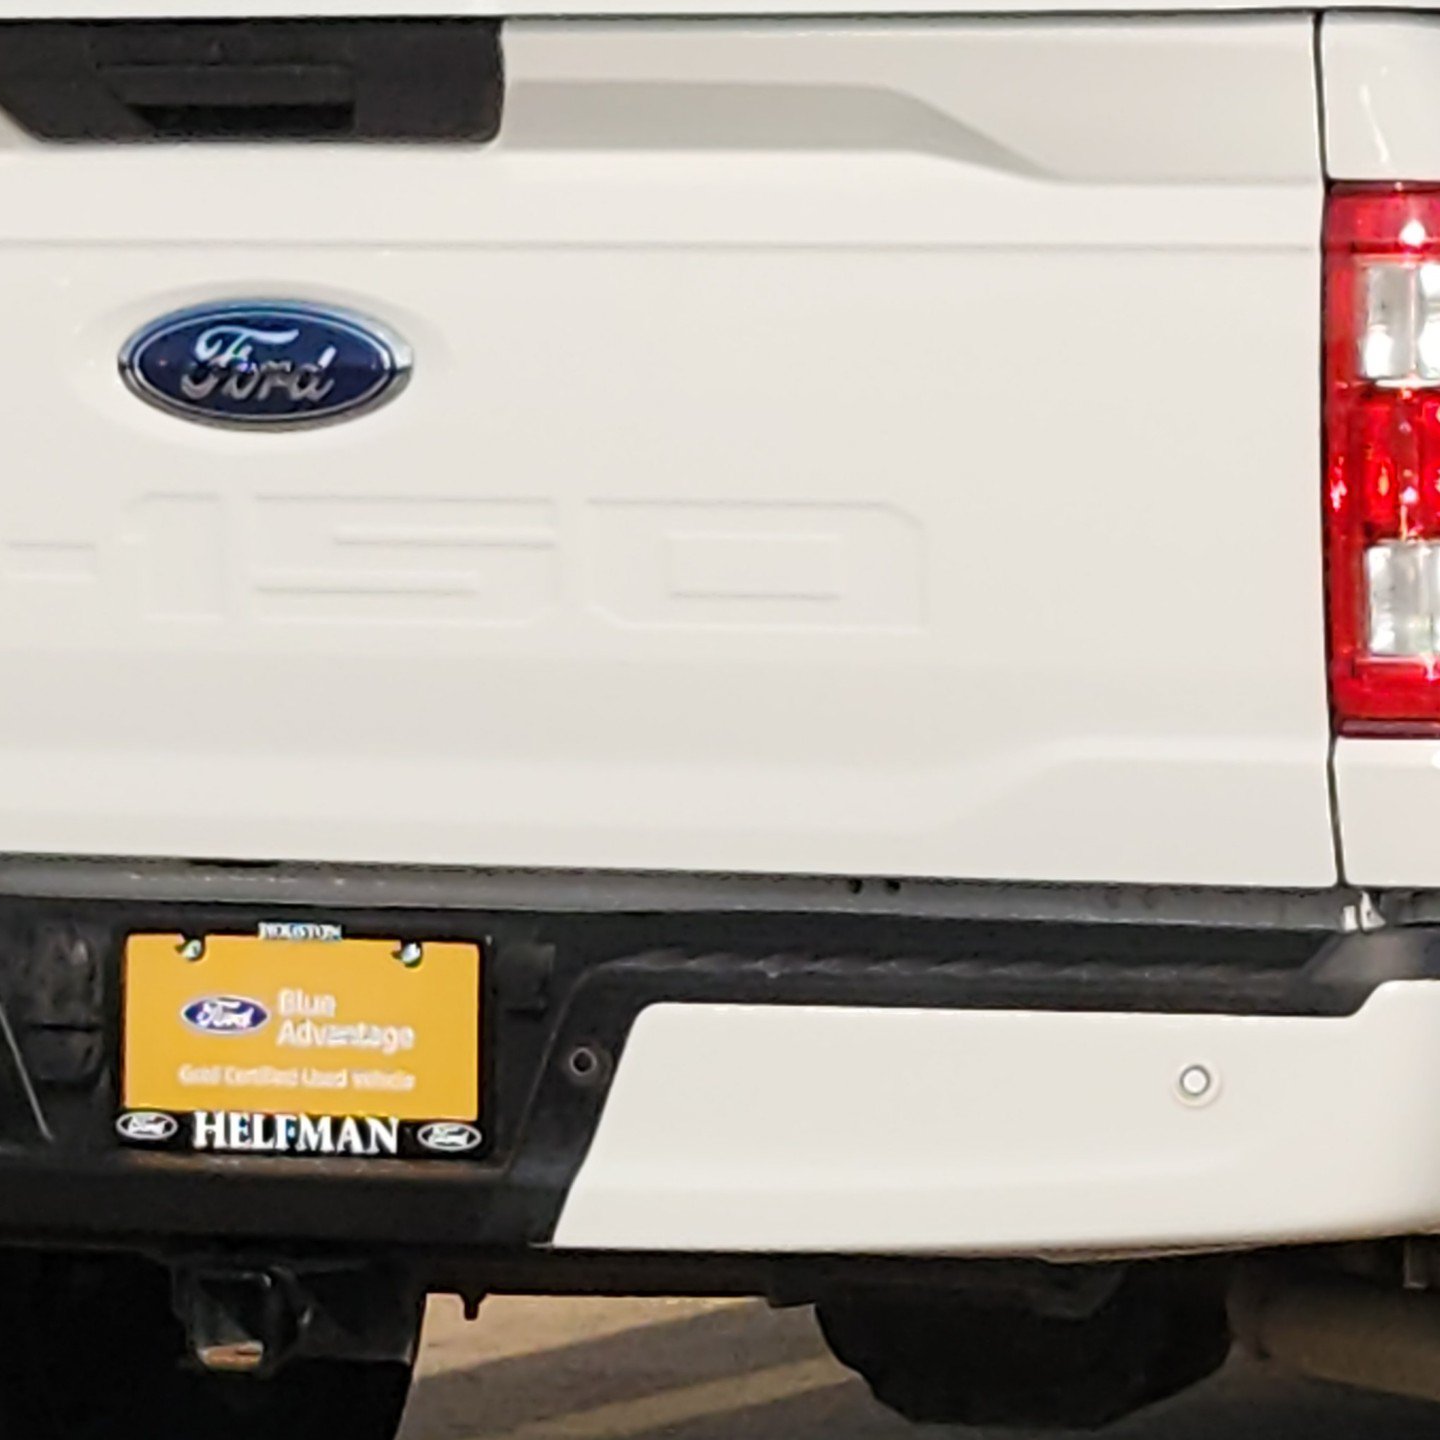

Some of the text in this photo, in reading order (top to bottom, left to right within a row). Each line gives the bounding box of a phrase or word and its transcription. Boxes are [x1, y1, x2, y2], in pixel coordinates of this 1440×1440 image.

[181, 324, 339, 403] Ford
[277, 989, 336, 1015] Blue
[277, 1019, 415, 1053] Advantage
[193, 1110, 400, 1155] HELFMAN
